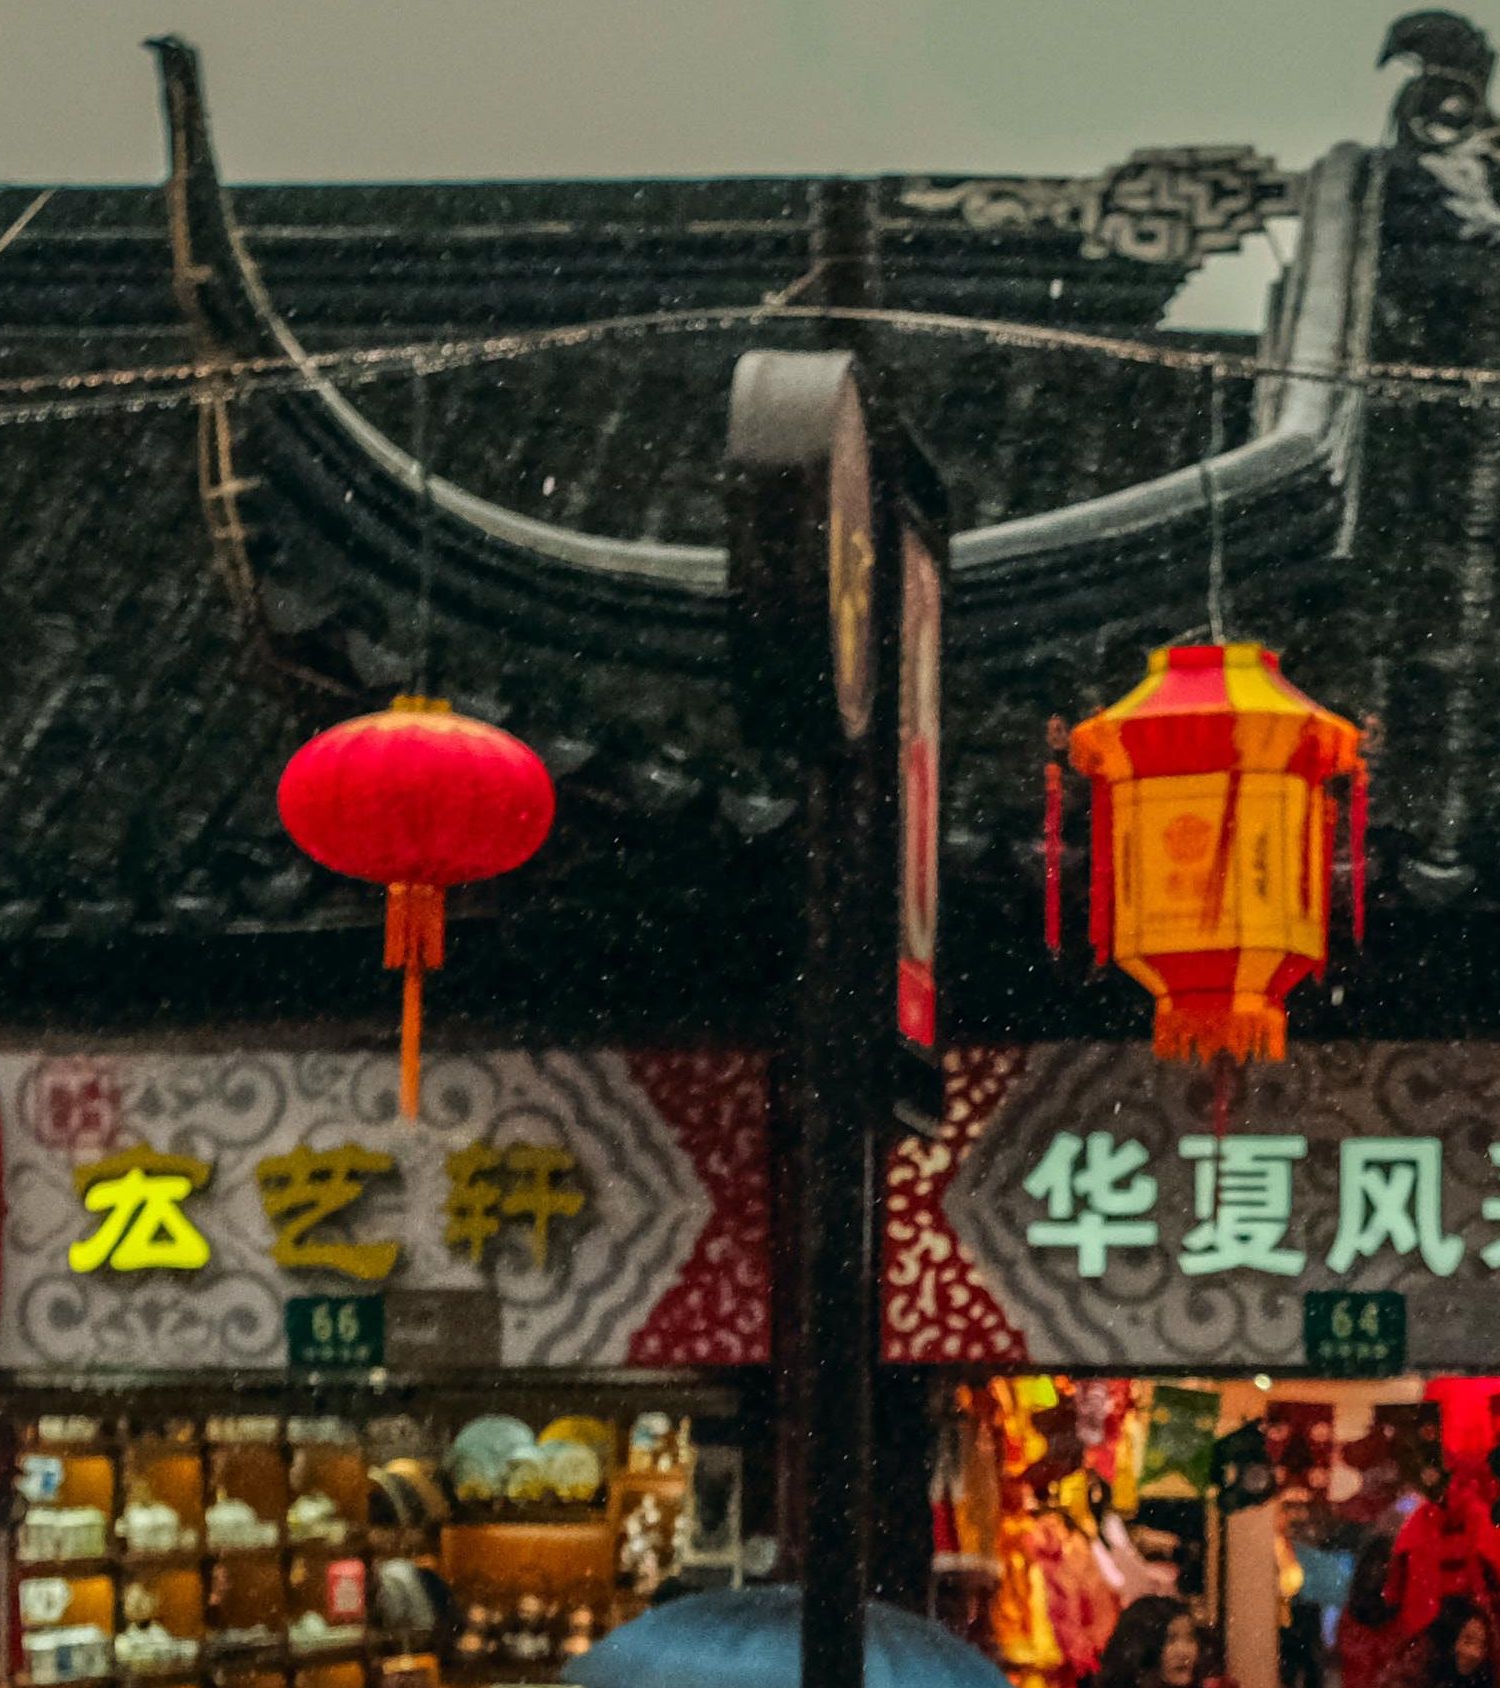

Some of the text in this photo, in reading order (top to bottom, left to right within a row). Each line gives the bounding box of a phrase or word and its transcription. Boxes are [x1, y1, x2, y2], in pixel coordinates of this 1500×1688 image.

[68, 1142, 584, 1279] 宏艺轩
[312, 1303, 359, 1342] 66
[1331, 1299, 1380, 1337] 64
